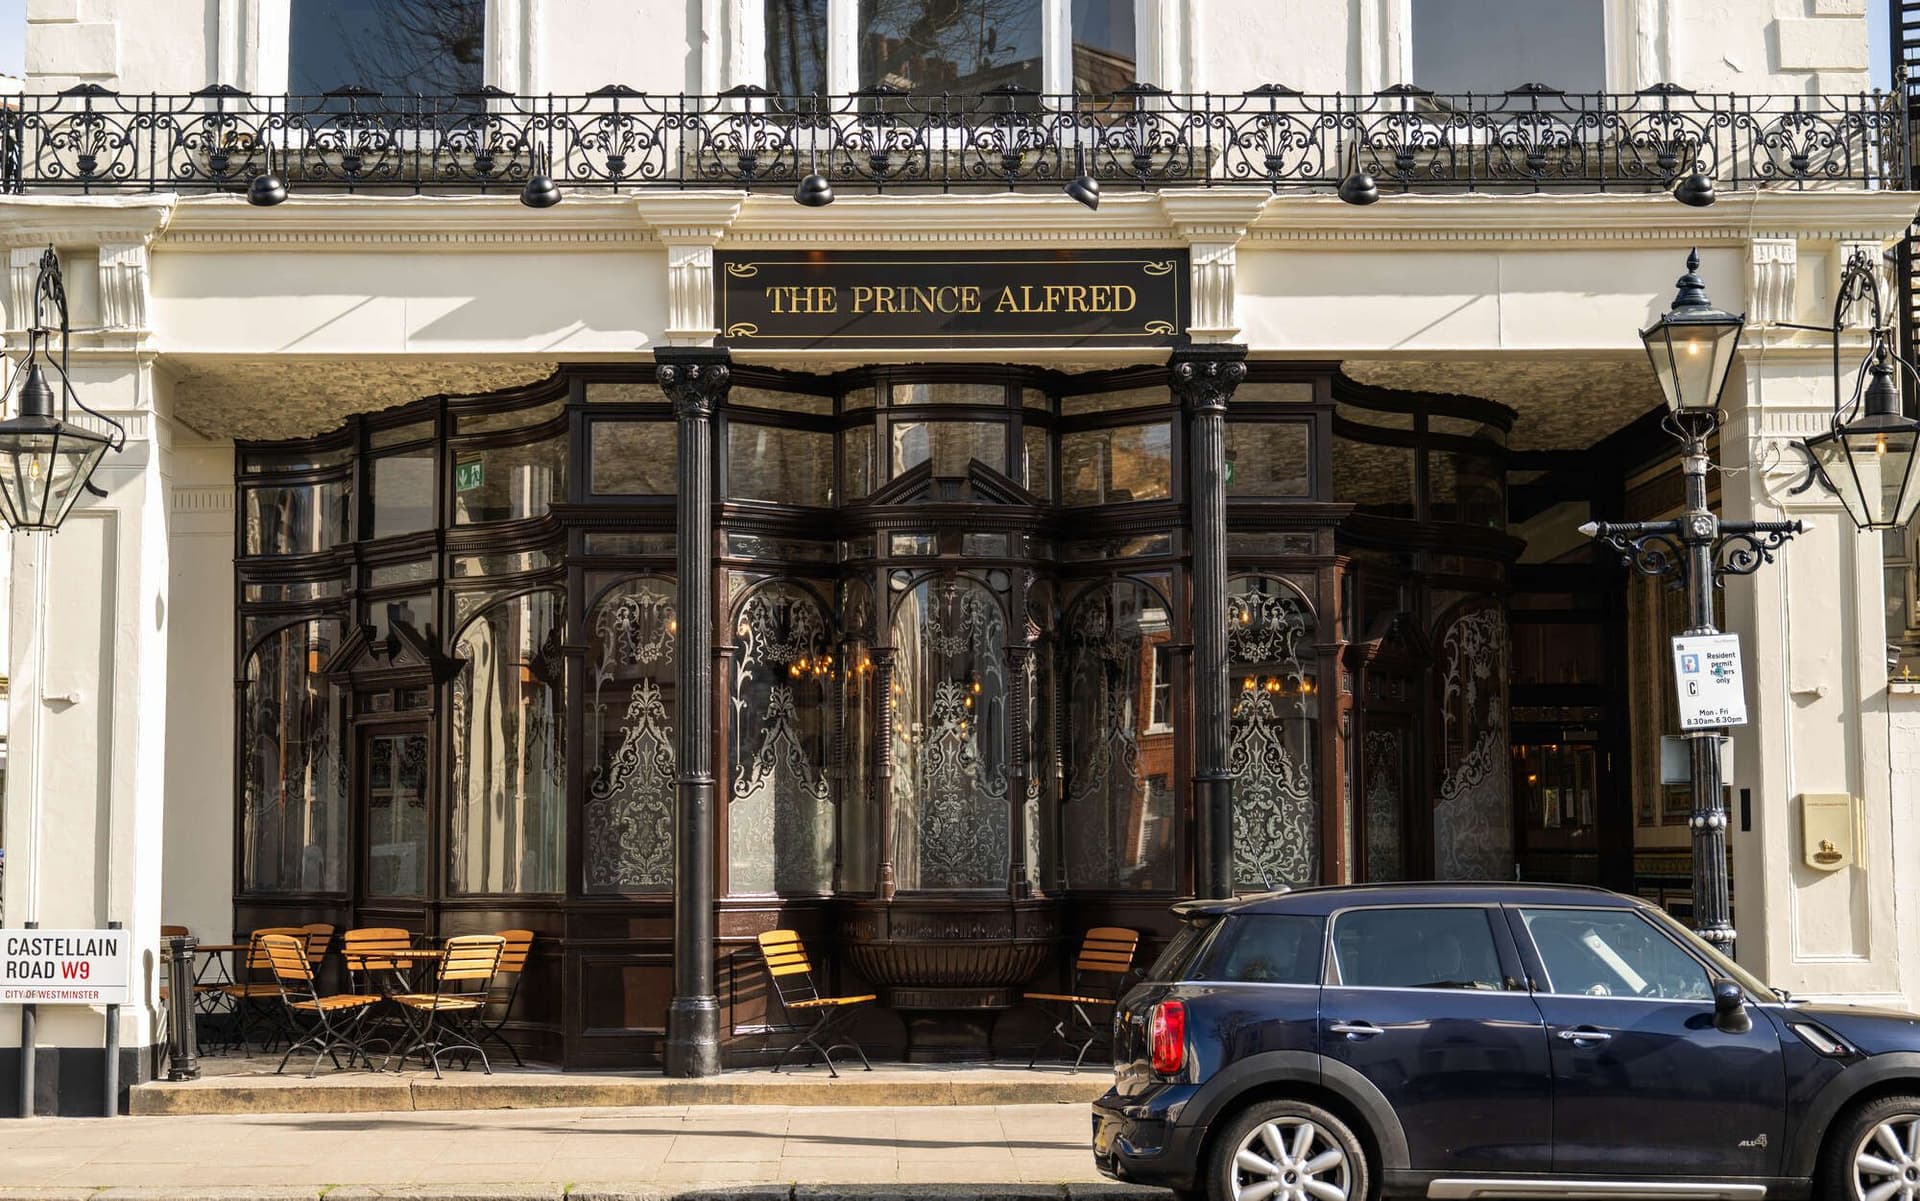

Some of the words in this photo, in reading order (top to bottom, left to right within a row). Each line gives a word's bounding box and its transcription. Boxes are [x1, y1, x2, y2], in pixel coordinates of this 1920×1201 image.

[766, 286, 838, 314] THE
[850, 286, 981, 313] PRINCE
[994, 285, 1137, 313] ALFRED
[1706, 652, 1736, 660] Resident
[1689, 682, 1696, 695] C
[7, 938, 118, 957] CASTELLAIN
[6, 960, 55, 979] ROAD
[61, 961, 91, 980] W9
[5, 990, 24, 999] CITY
[25, 990, 36, 999] OF
[37, 990, 99, 999] WESTMINSTER
